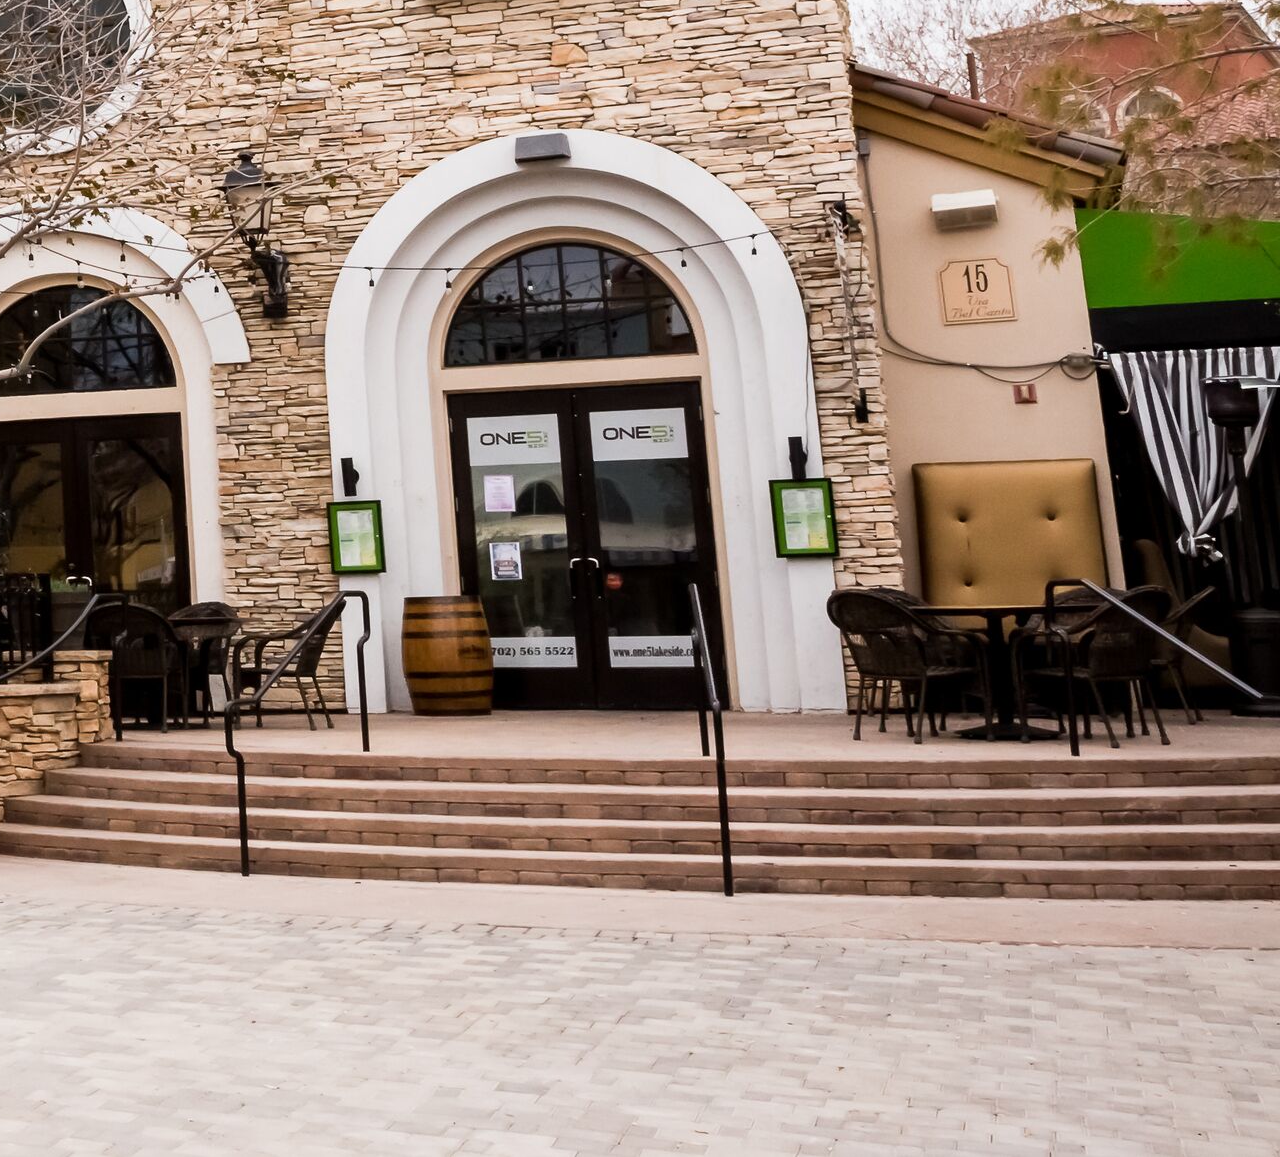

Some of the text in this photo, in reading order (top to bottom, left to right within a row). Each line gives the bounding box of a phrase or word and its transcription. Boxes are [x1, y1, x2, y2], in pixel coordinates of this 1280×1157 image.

[962, 263, 989, 294] 15
[967, 295, 989, 306] Via
[491, 646, 574, 657] 702) 565 5522
[612, 646, 695, 657] www.one5lakeside.co
